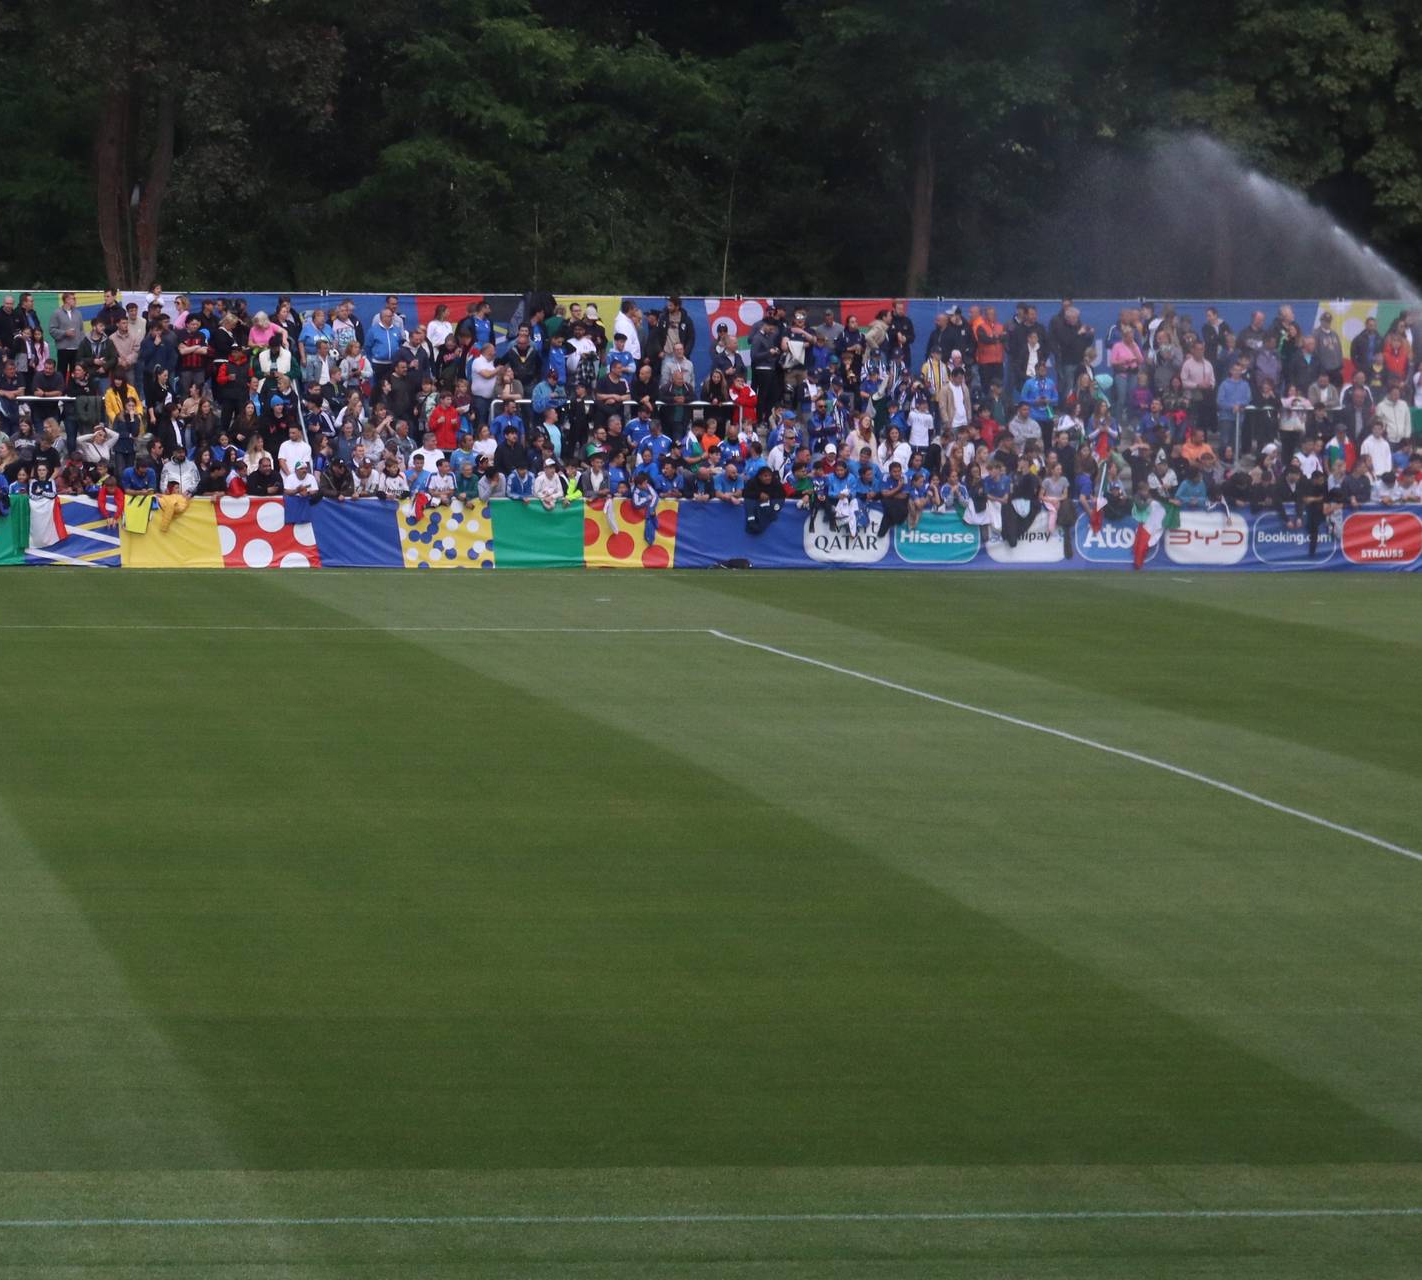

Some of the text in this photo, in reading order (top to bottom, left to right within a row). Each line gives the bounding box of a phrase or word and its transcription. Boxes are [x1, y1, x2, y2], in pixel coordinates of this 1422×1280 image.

[815, 535, 878, 553] QATAR
[899, 530, 975, 545] Hisense
[1016, 530, 1051, 543] lipay
[1083, 524, 1136, 549] Ato
[1169, 530, 1244, 546] BYD
[1257, 531, 1332, 545] Booking.cm
[1361, 549, 1404, 559] STRAUSS
